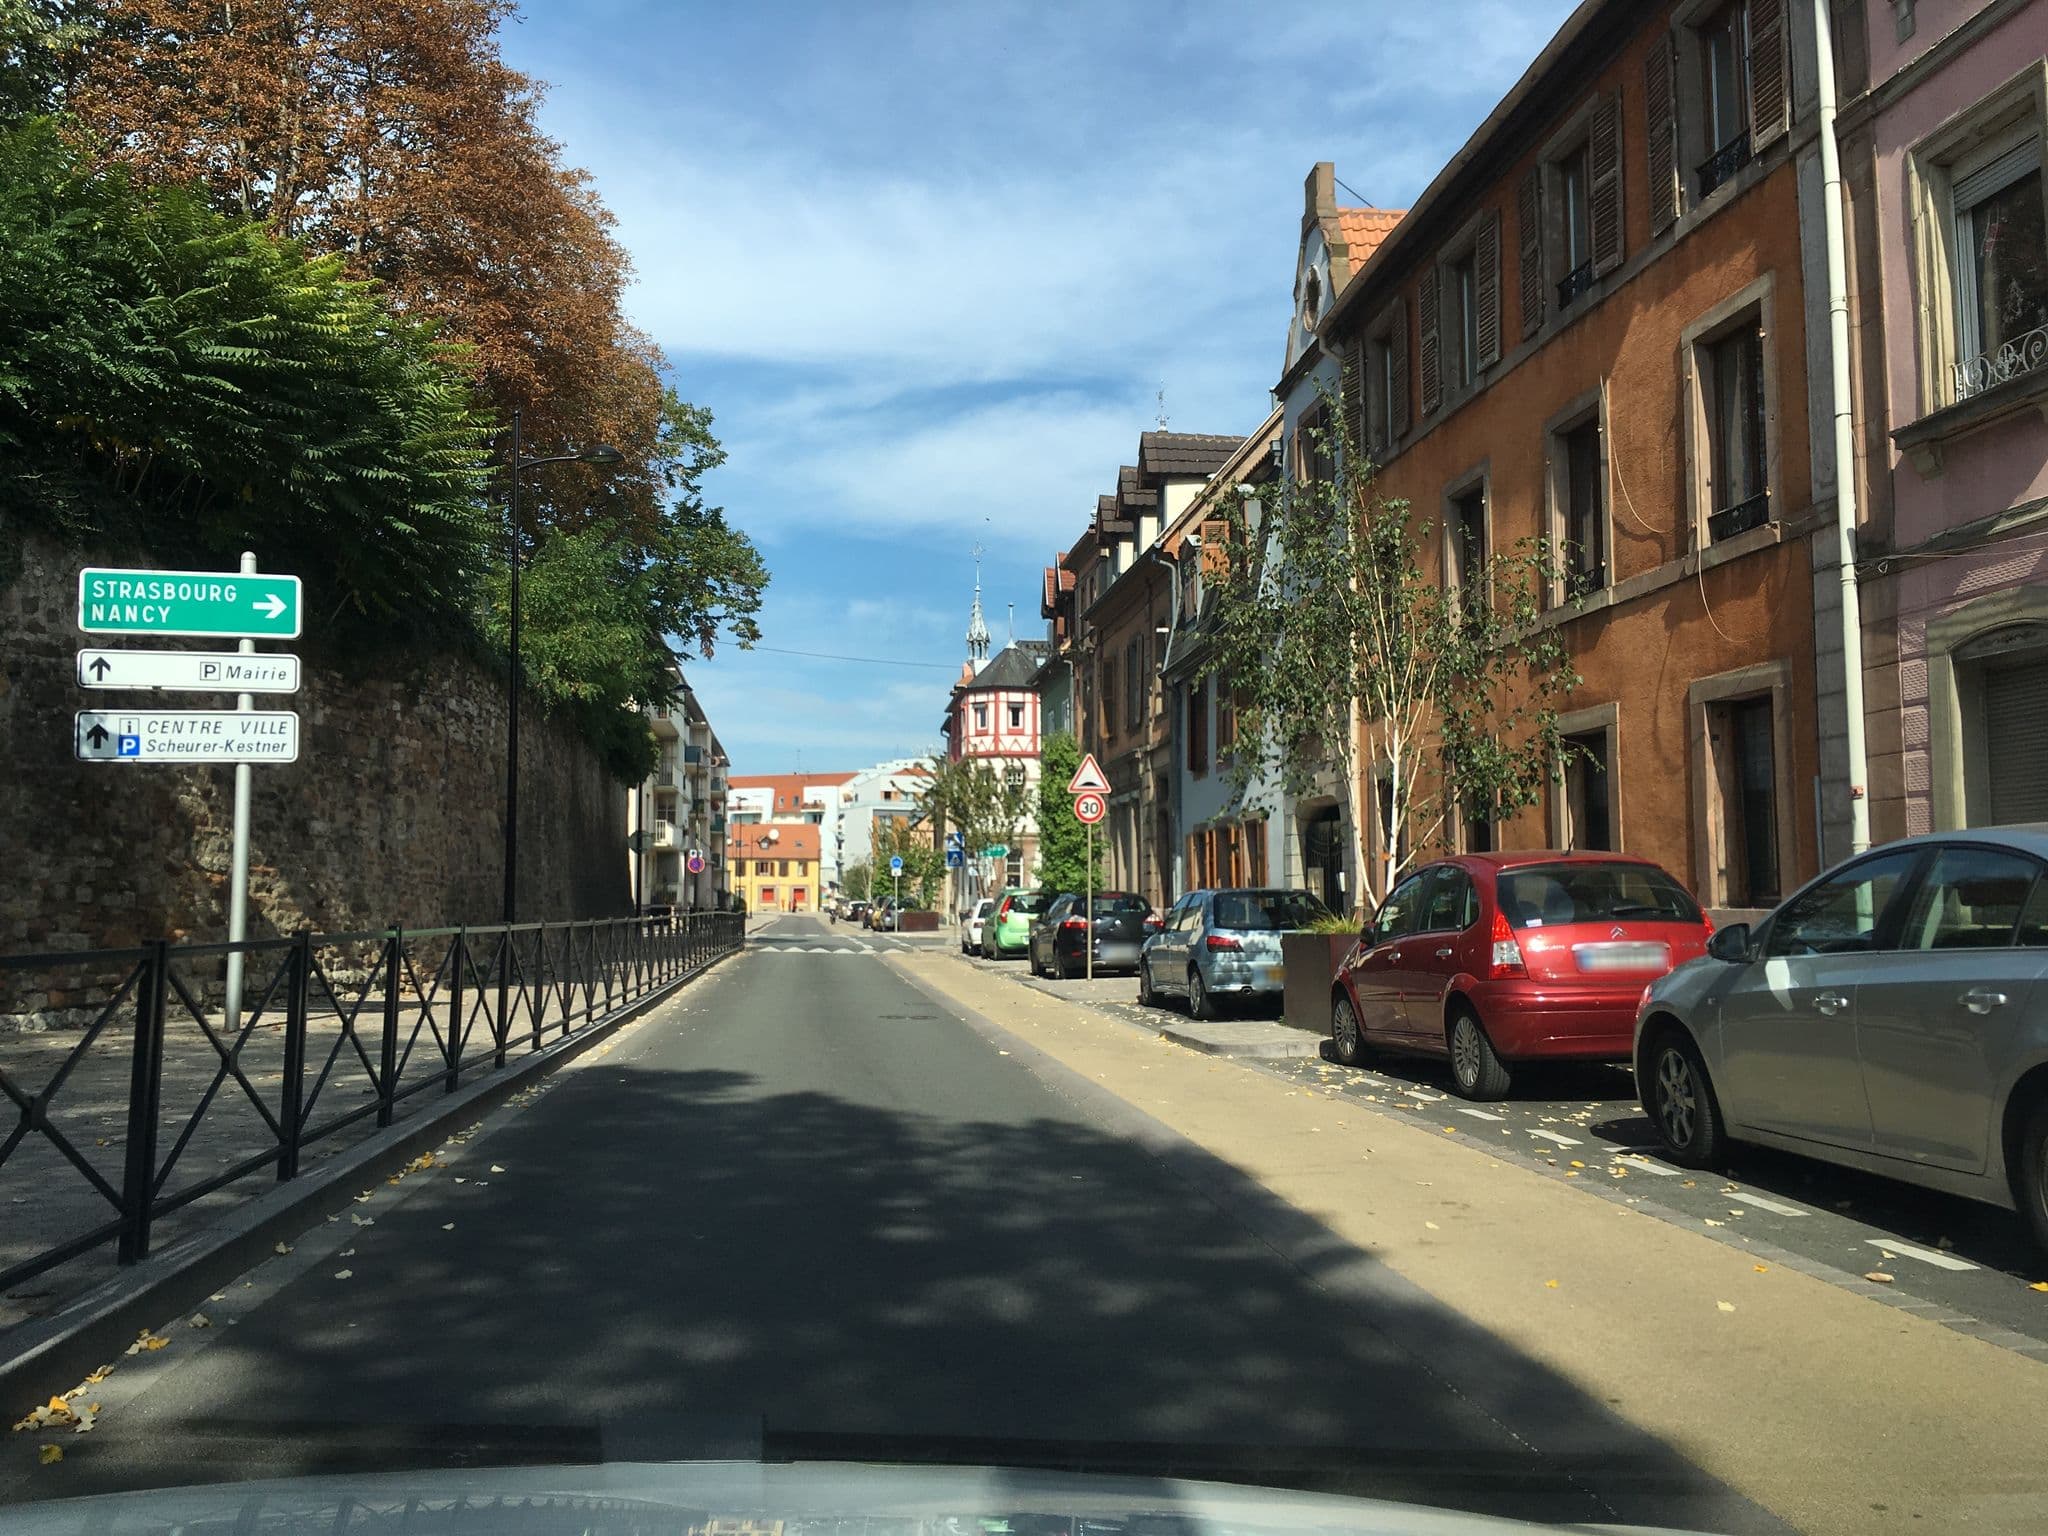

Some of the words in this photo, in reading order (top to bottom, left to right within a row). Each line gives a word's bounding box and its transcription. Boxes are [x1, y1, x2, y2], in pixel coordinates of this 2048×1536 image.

[92, 580, 237, 602] STRASBOURG
[91, 603, 171, 623] NANCY
[204, 664, 216, 678] P
[226, 665, 287, 680] Mairie
[147, 720, 223, 735] CENTRE
[240, 721, 289, 735] VILLE
[122, 738, 136, 755] P
[146, 738, 288, 753] Scheurer-Kestner
[1081, 801, 1099, 814] 30
